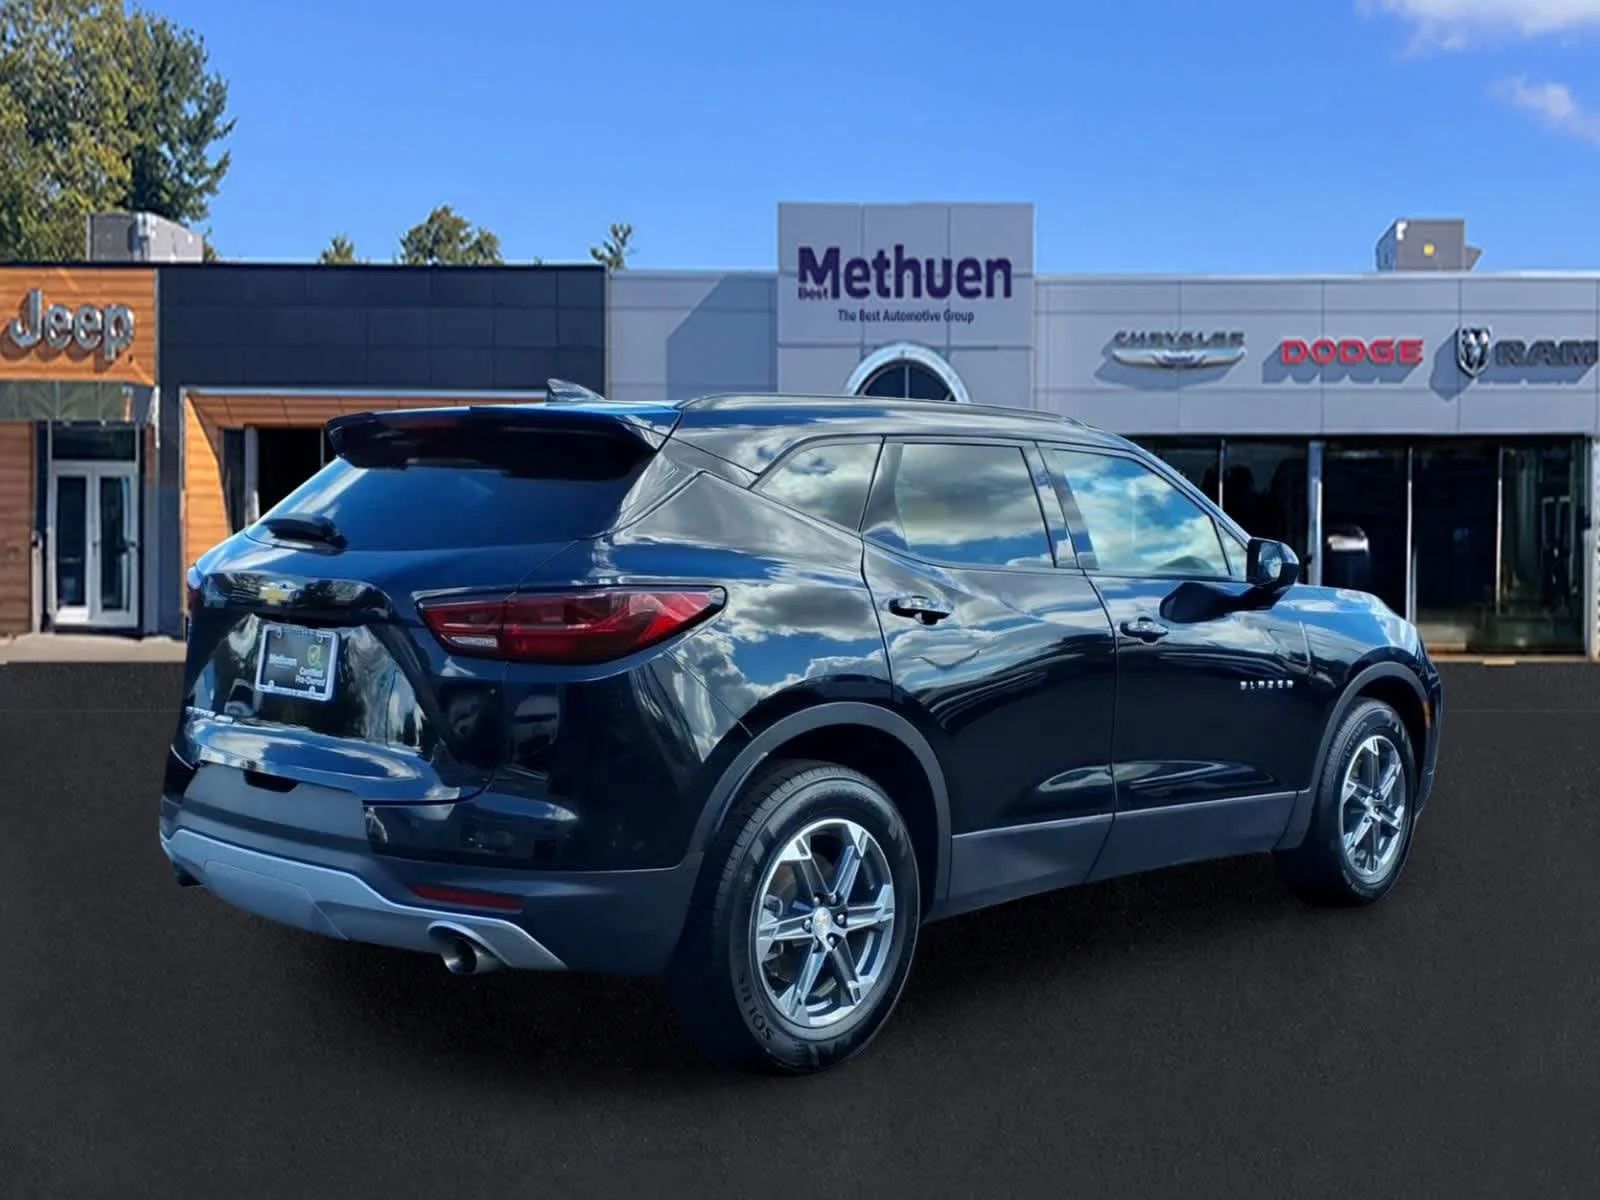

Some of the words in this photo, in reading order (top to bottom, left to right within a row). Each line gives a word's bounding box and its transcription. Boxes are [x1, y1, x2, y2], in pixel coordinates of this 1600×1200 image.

[798, 244, 1012, 299] Methuen
[8, 287, 135, 361] Jeep
[838, 309, 856, 321] The
[859, 309, 880, 321] Best
[882, 308, 941, 322] Automotive
[943, 308, 974, 324] Group
[1114, 331, 1245, 348] CHRYSLER
[1281, 337, 1423, 365] DODGE
[1493, 339, 1598, 366] RAM
